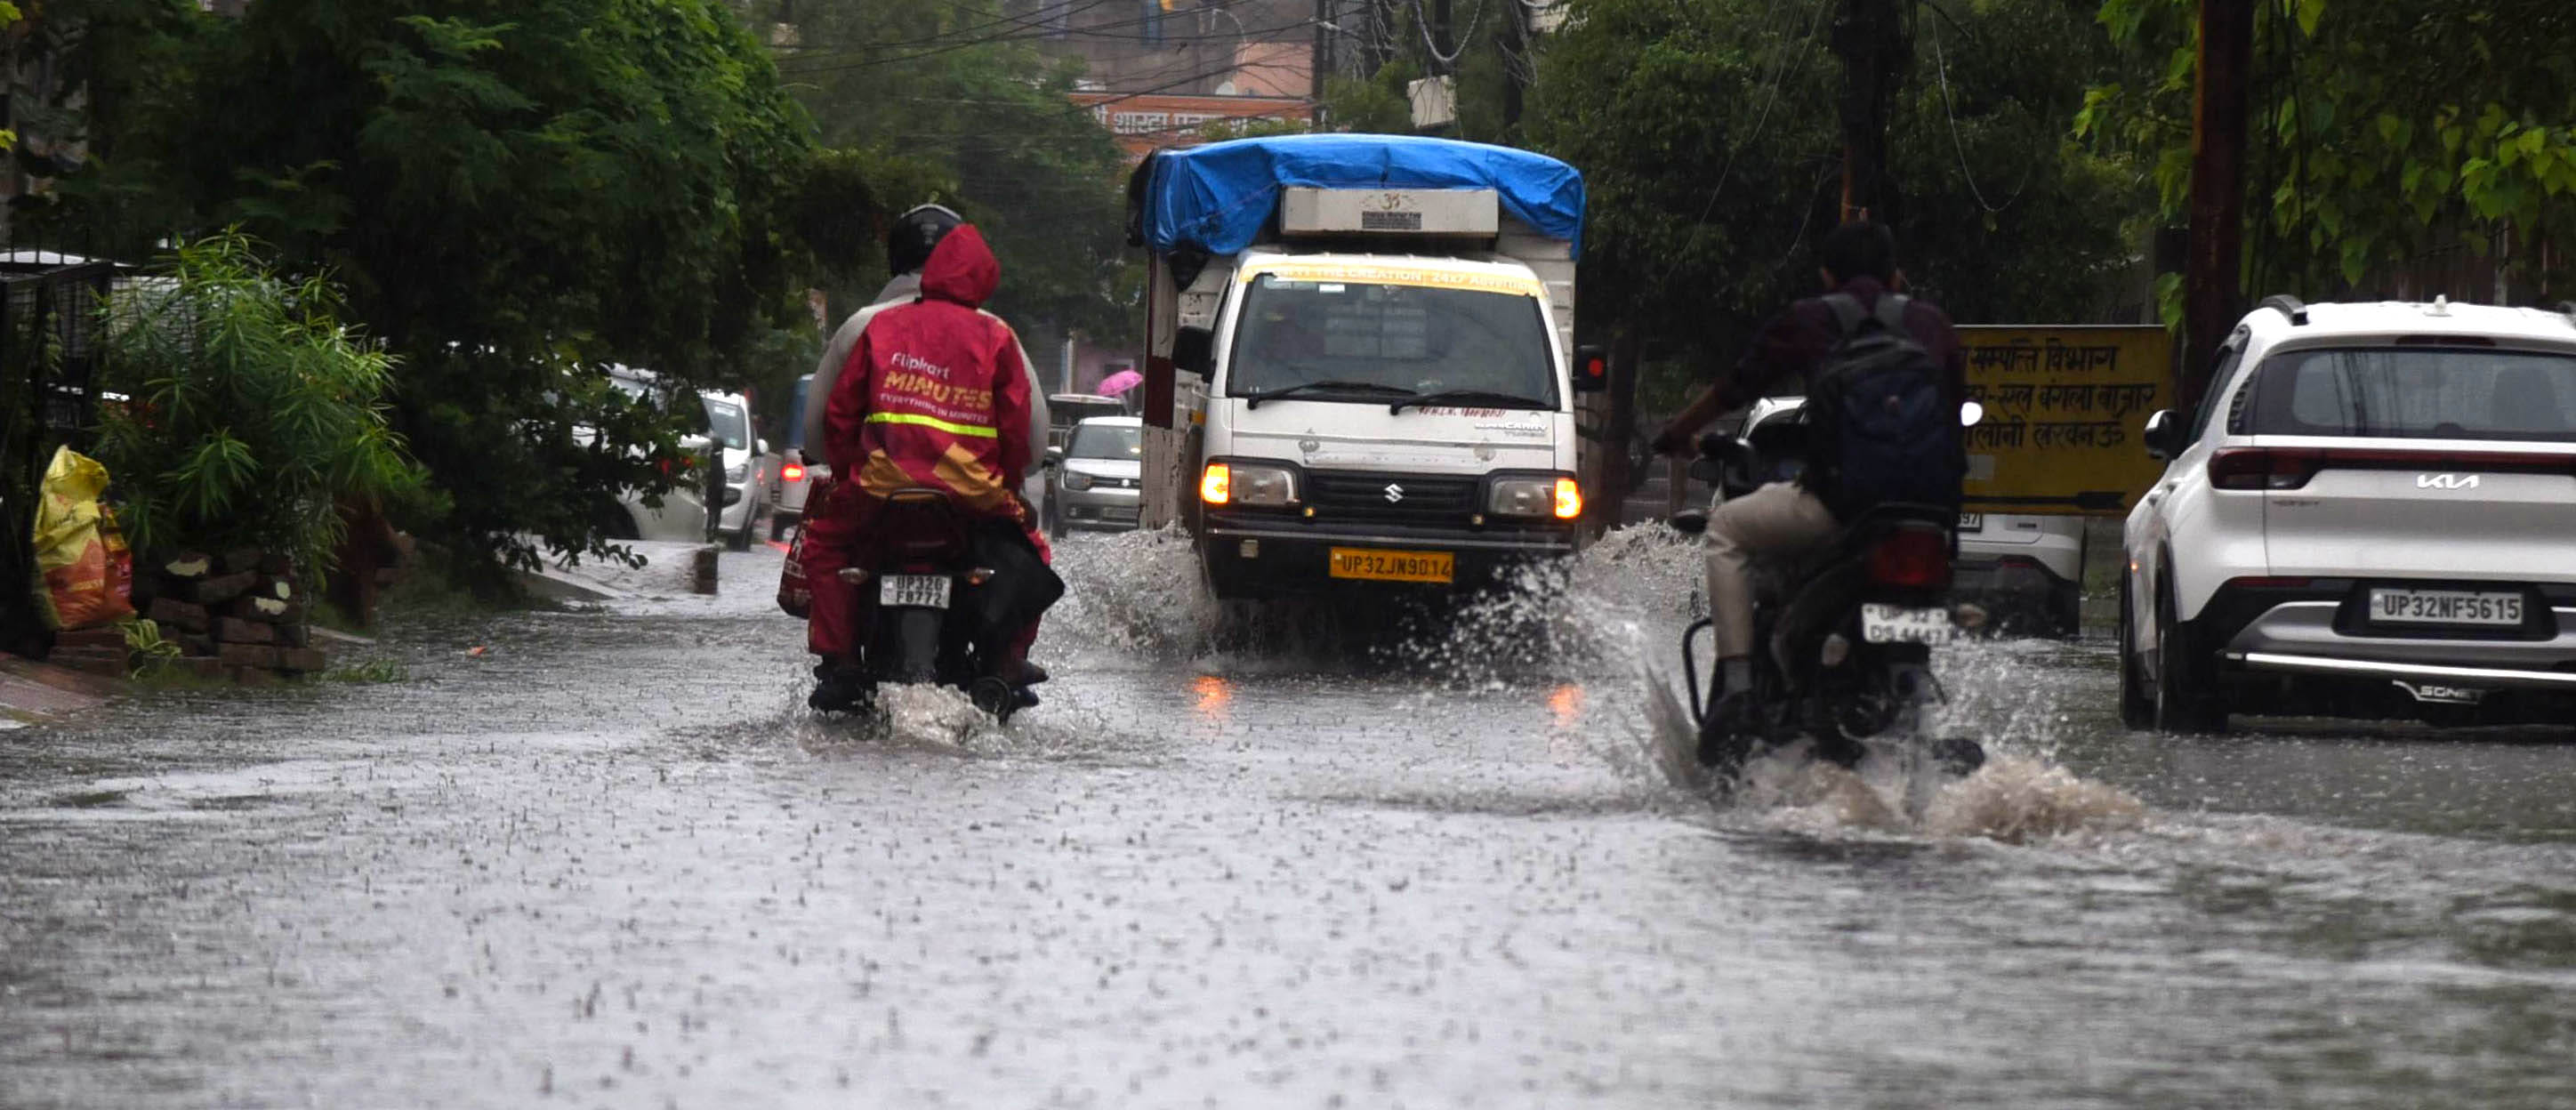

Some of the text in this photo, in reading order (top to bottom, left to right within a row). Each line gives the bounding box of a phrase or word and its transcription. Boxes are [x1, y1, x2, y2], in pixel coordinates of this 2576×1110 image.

[891, 352, 950, 380] Flipkart
[883, 371, 994, 411] MINUTES
[938, 406, 948, 417] IN
[949, 410, 989, 425] MINUTES
[2417, 474, 2480, 489] KIA
[1342, 554, 1452, 577] UP32JN9014
[2384, 594, 2520, 620] UP32NF5615
